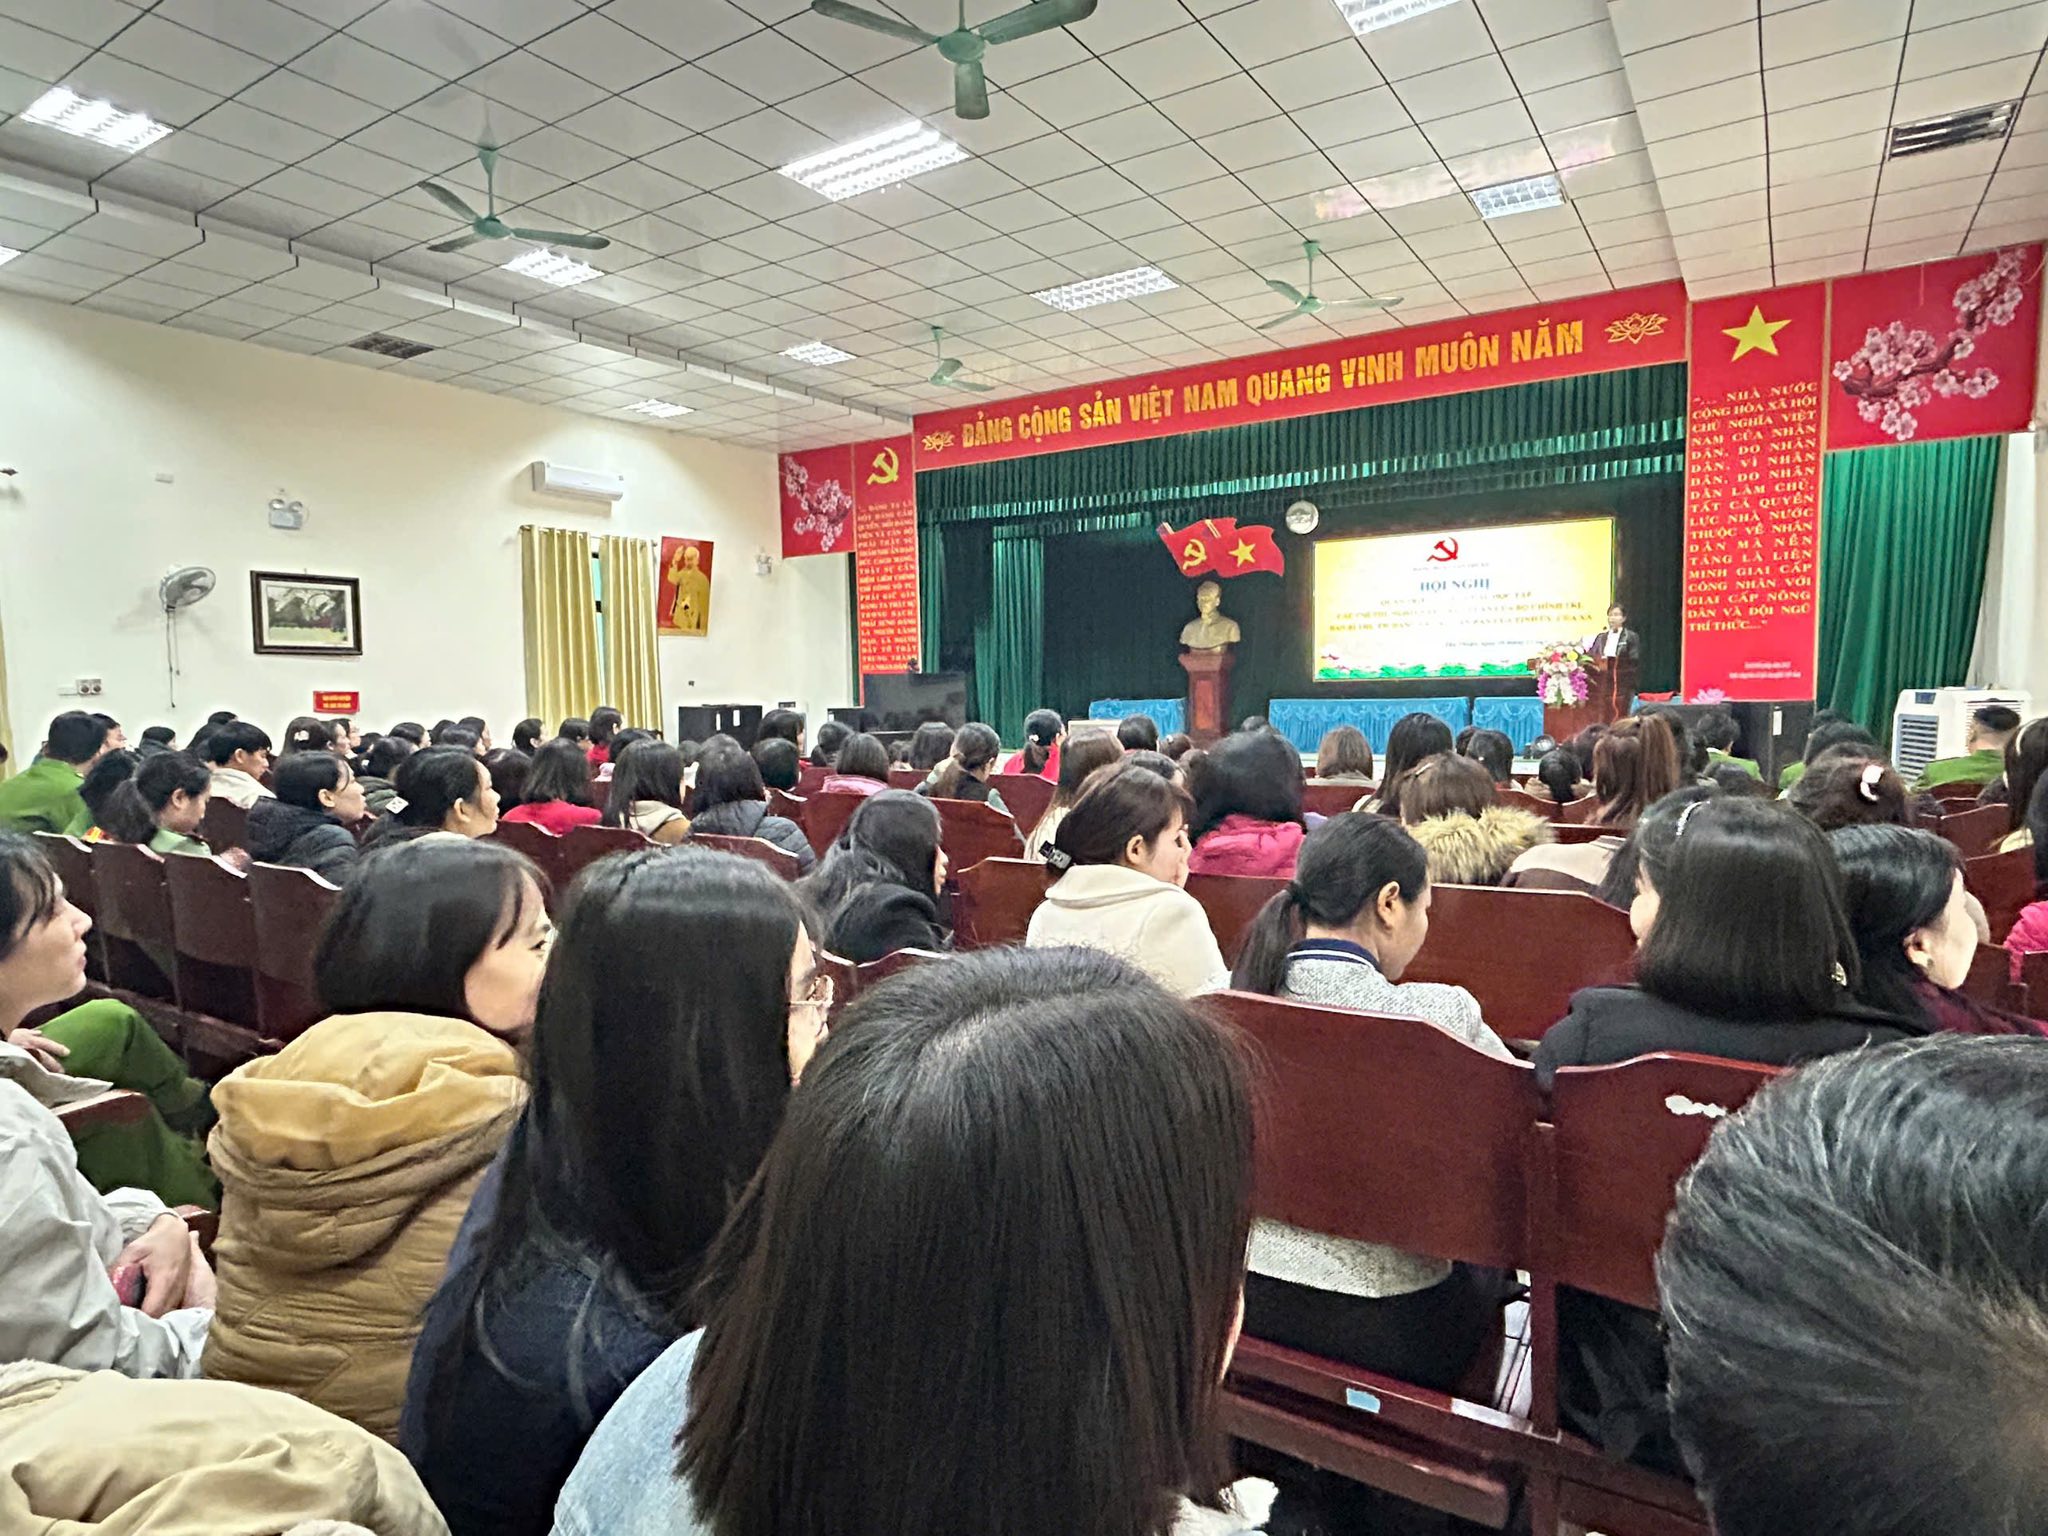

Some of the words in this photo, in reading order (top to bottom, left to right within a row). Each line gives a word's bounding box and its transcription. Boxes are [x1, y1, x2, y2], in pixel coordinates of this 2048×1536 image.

[962, 411, 1013, 448] ĐẢNG
[1018, 405, 1072, 442] CỘNG
[1079, 391, 1121, 429] SẢN
[1129, 385, 1174, 424] VIỆT
[1184, 378, 1238, 413] NAM
[1246, 363, 1331, 406] QUANG
[1341, 351, 1404, 389] VINH
[1415, 332, 1499, 378] MUÔN
[1511, 319, 1583, 363] NĂM
[1727, 388, 1760, 401] NHÀ
[1769, 381, 1817, 396] NƯỚC
[1692, 407, 1731, 420] CỘNG
[1734, 402, 1764, 415] HÒA
[1768, 398, 1787, 410] XÃ
[1791, 396, 1817, 408] HỘI
[1692, 420, 1718, 433] CHỦ
[1729, 414, 1773, 428] NGHĨA
[1781, 410, 1816, 422] VIỆT
[1692, 435, 1724, 446] NAM
[1731, 429, 1763, 441] CỦA
[1772, 423, 1816, 437] NHÂN
[1738, 444, 1761, 455] DO
[1770, 437, 1816, 451] NHÂN
[1741, 456, 1757, 468] VÌ
[1768, 451, 1816, 465] NHÂN
[1738, 472, 1759, 482] DO
[1769, 465, 1815, 478] NHÂN
[1691, 488, 1722, 500] DÂN
[1732, 484, 1765, 497] LÀM
[1691, 500, 1720, 513] TẤT
[1730, 498, 1750, 510] CẢ
[1759, 492, 1814, 508] QUYỀN
[1690, 514, 1719, 527] LỰC
[1728, 510, 1761, 523] NHÀ
[1769, 507, 1814, 520] NƯỚC
[1691, 527, 1737, 540] THUỘC
[1745, 522, 1764, 535] VỀ
[1772, 520, 1813, 533] NHÂN
[1690, 541, 1726, 553] DÂN
[1738, 537, 1762, 549] MÀ
[1774, 533, 1813, 547] NỀN
[1690, 554, 1733, 566] TẢNG
[1742, 551, 1763, 563] LÀ
[1773, 548, 1812, 561] LIÊN
[1689, 568, 1728, 579] MINH
[1736, 566, 1770, 577] GIAI
[1779, 561, 1812, 574] CẤP
[1688, 580, 1728, 592] CÔNG
[1736, 577, 1776, 590] NHÂN
[1785, 575, 1811, 587] VỚI
[1687, 595, 1720, 605] GIAI
[1728, 591, 1758, 603] CẤP
[1767, 589, 1810, 602] NÔNG
[1688, 608, 1716, 619] DÂN
[1723, 606, 1742, 617] VÀ
[1749, 604, 1774, 617] ĐỘI
[1781, 602, 1810, 615] NGŨ
[1689, 619, 1711, 632] TRÍ
